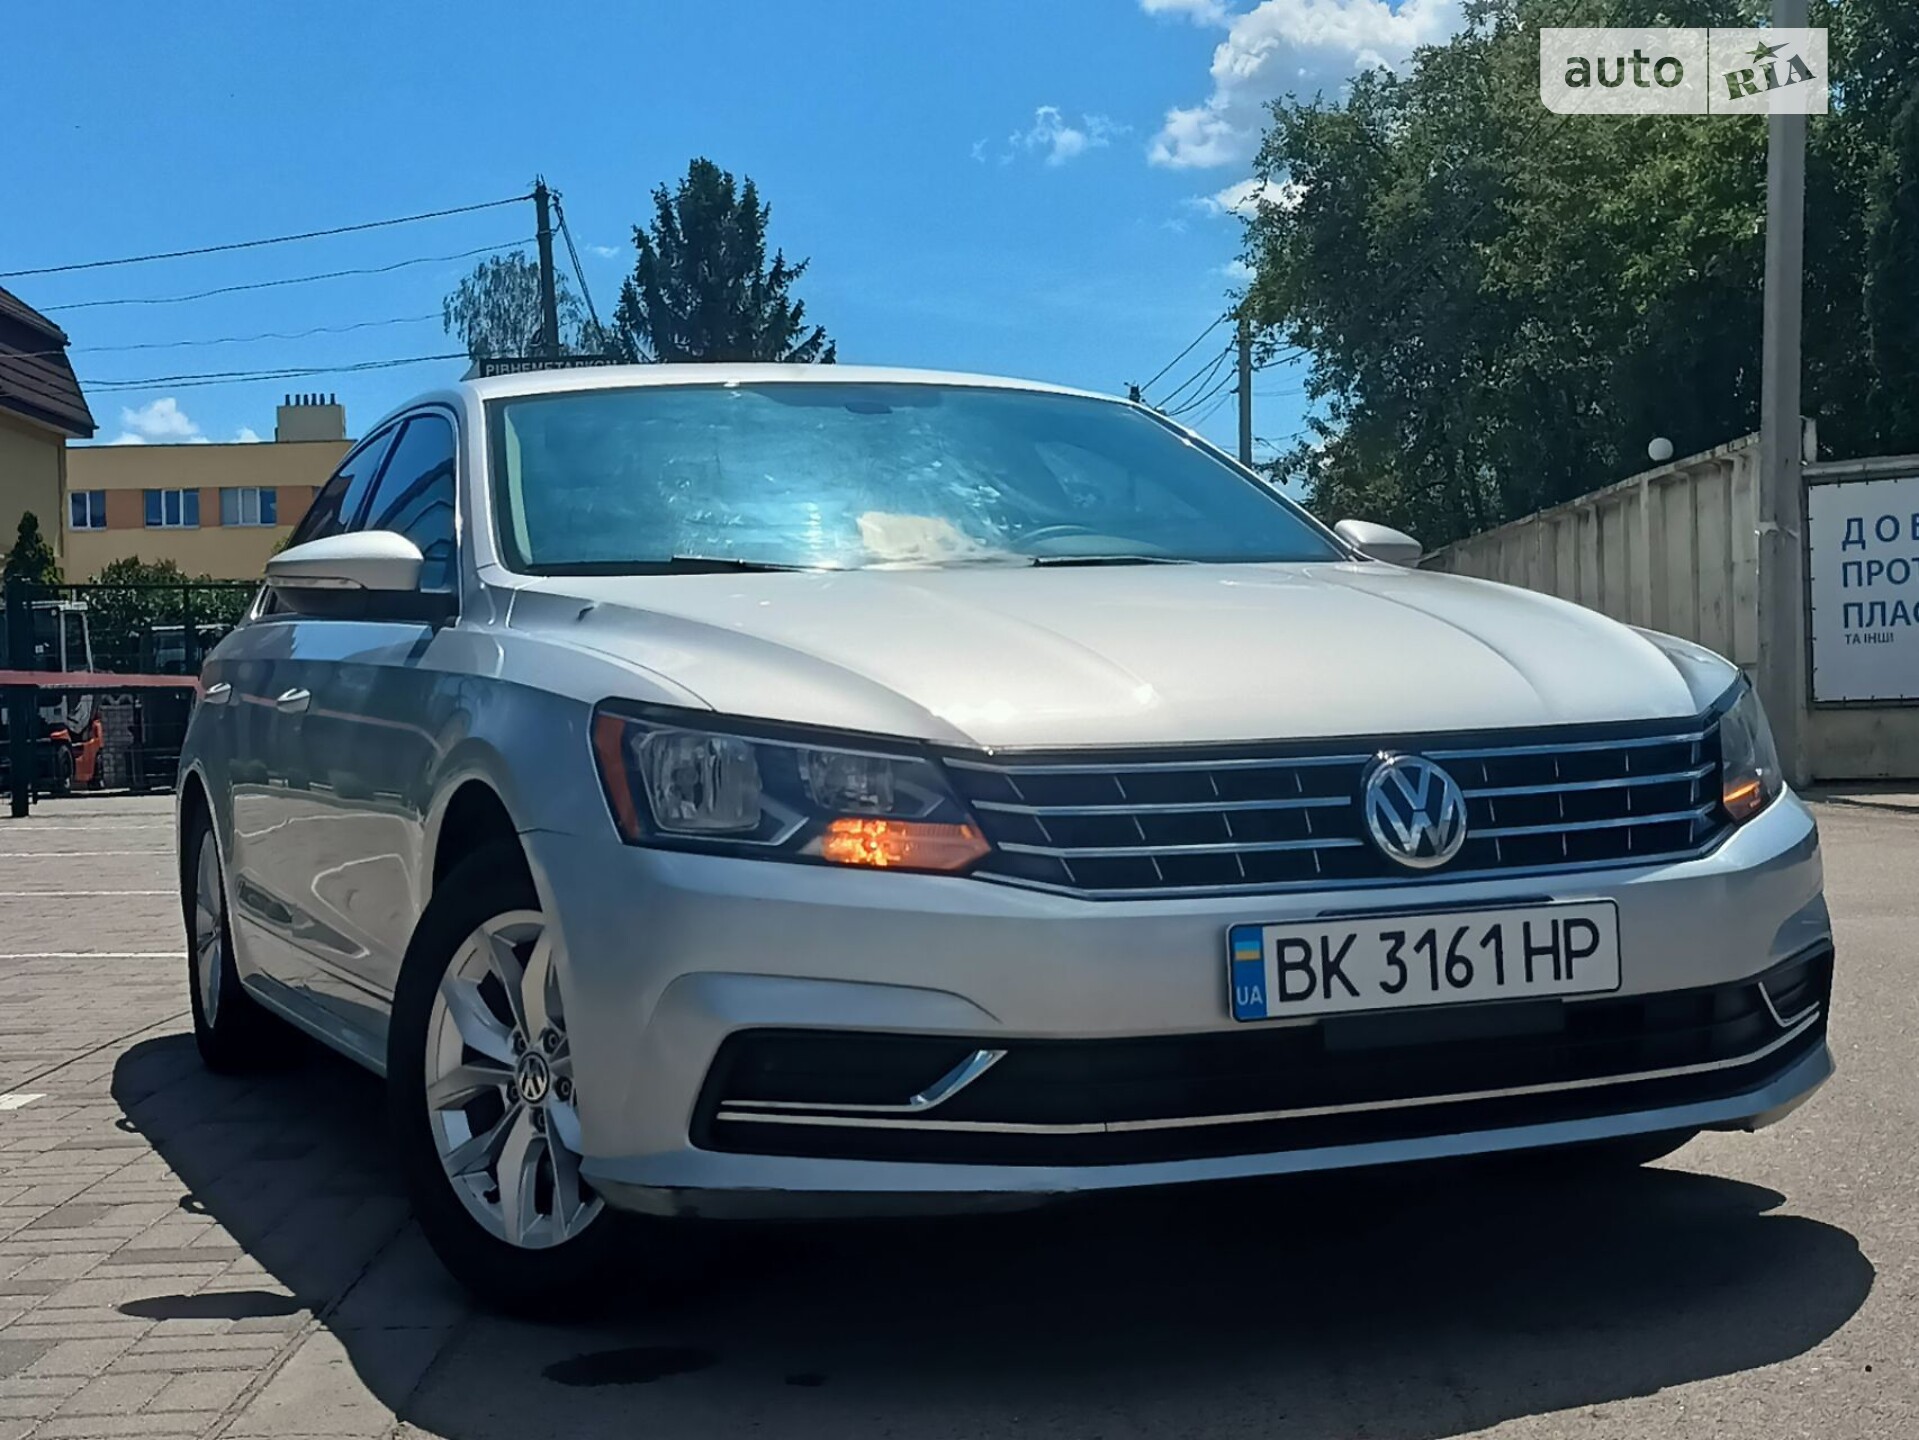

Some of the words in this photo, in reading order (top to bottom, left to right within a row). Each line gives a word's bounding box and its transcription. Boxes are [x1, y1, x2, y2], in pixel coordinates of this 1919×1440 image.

[1845, 633, 1861, 645] ТА
[1275, 933, 1360, 1003] BK
[1378, 923, 1505, 994] 3161
[1522, 917, 1601, 983] HP
[1236, 984, 1263, 1006] UA
